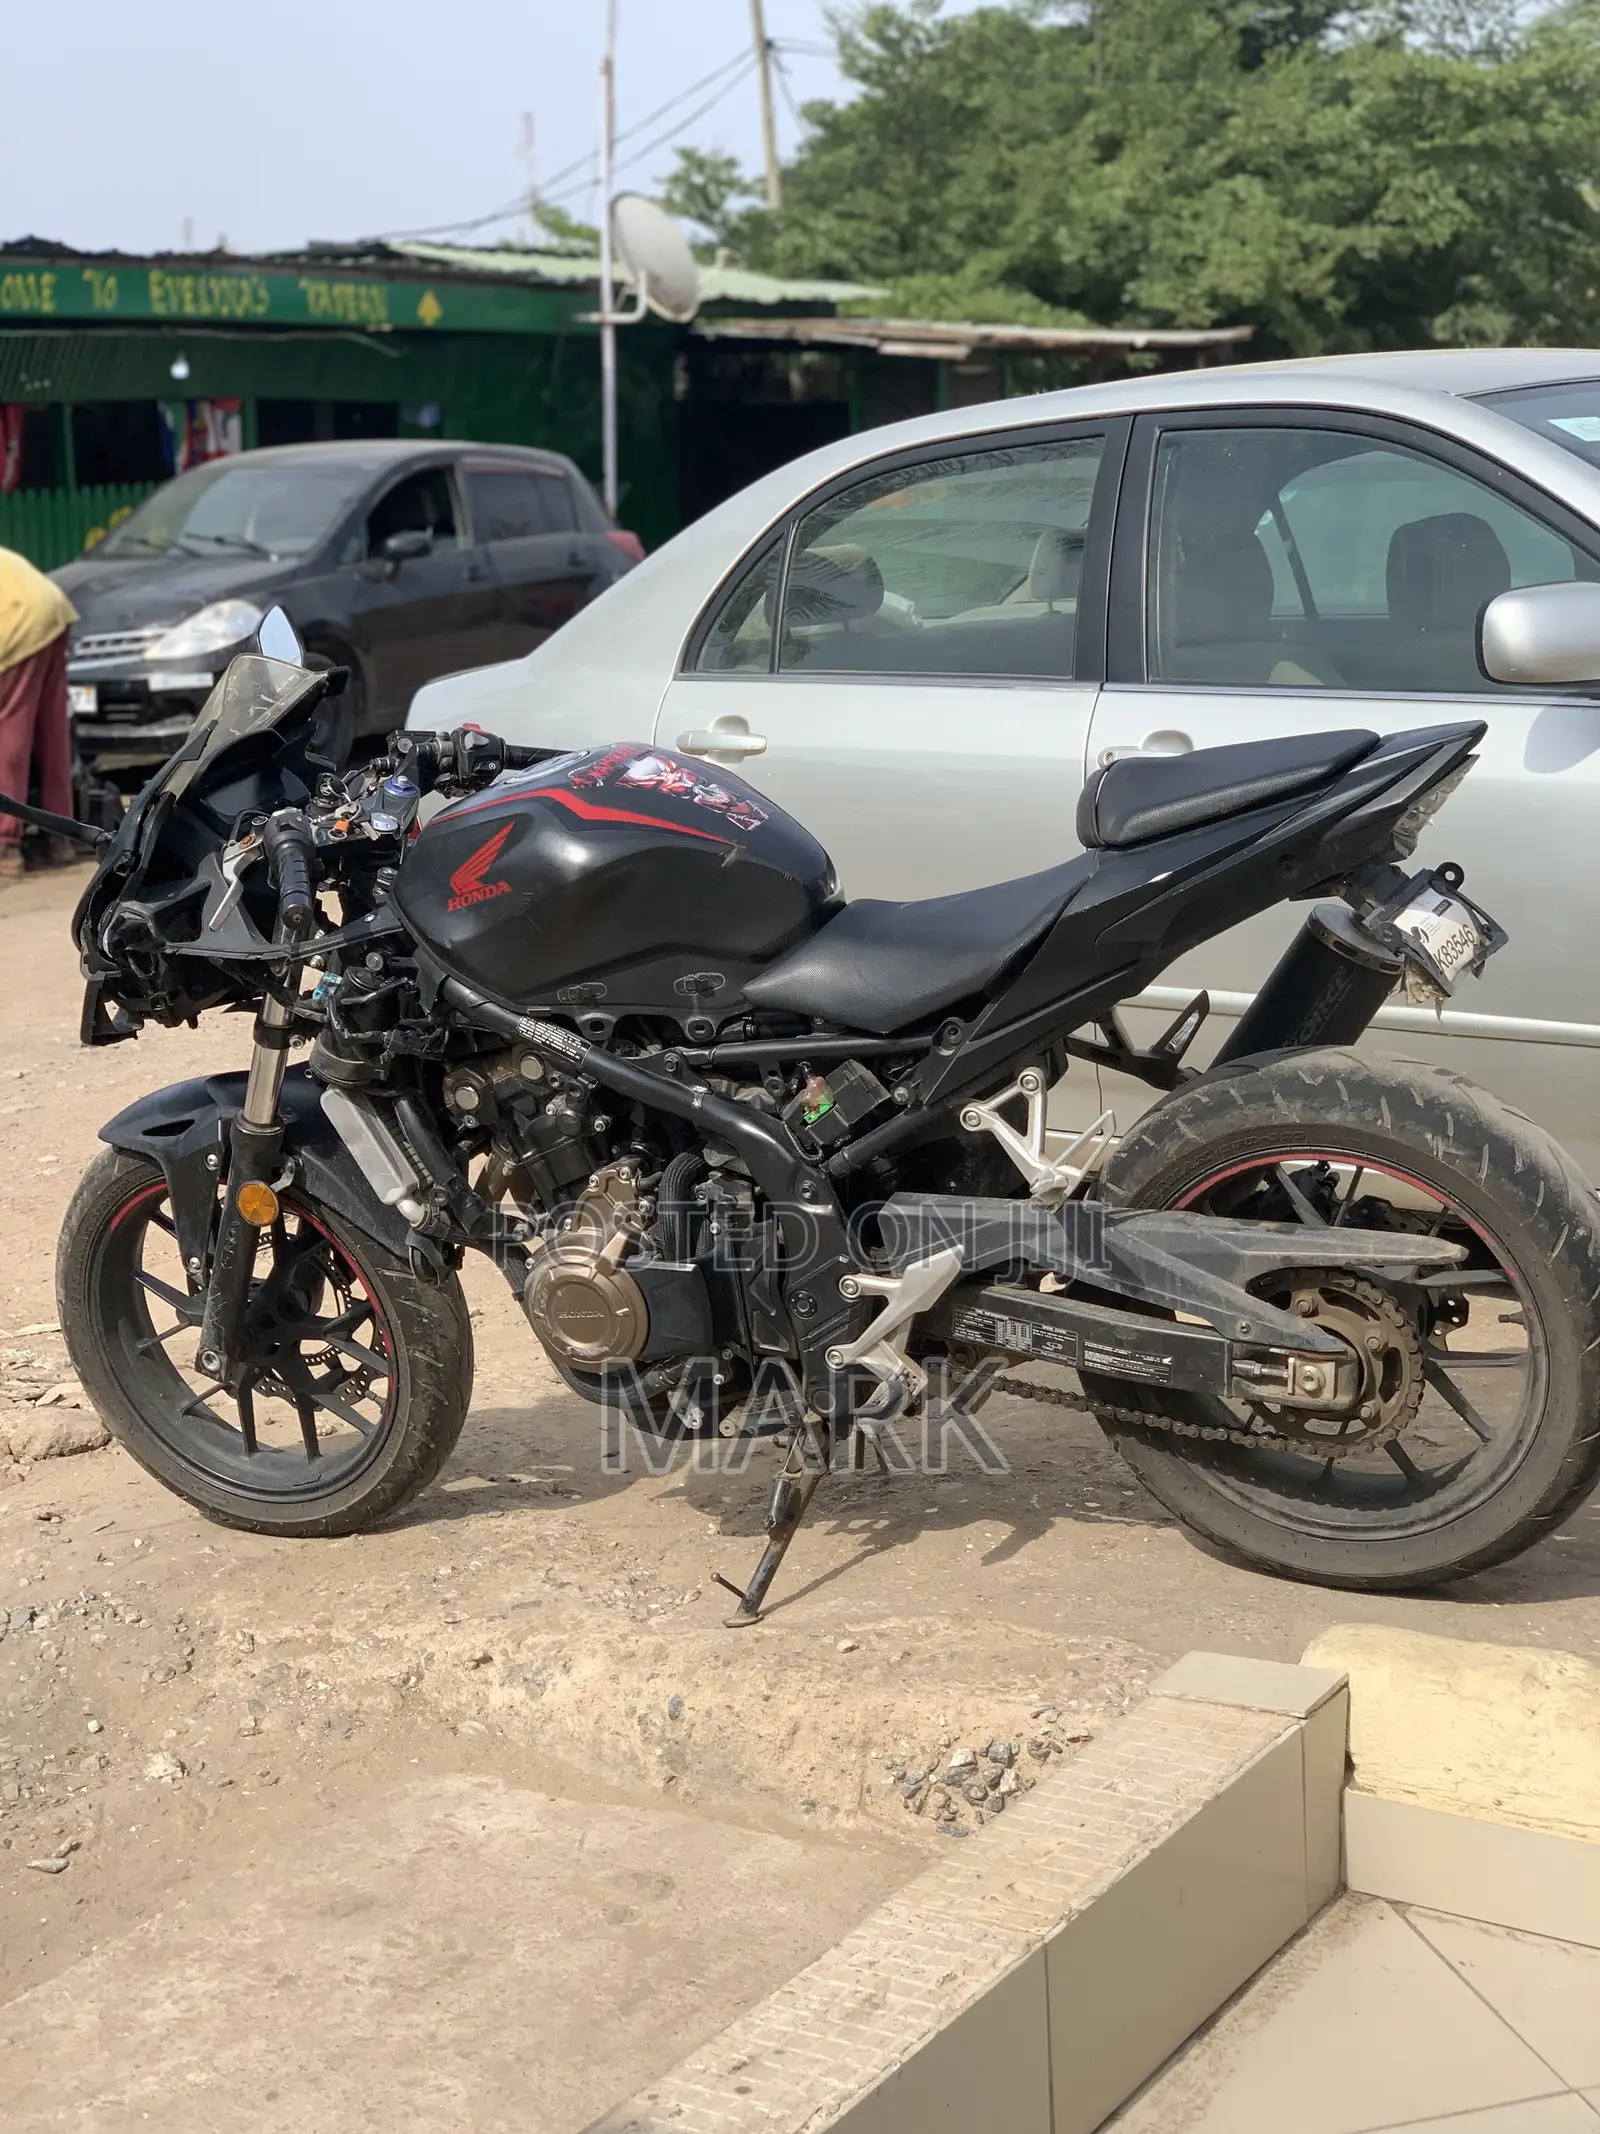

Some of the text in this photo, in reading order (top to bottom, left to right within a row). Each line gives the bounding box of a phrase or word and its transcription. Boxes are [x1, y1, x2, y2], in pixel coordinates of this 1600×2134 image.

[82, 269, 118, 311] TO
[447, 880, 512, 912] HONDA
[557, 1310, 605, 1319] HONDA
